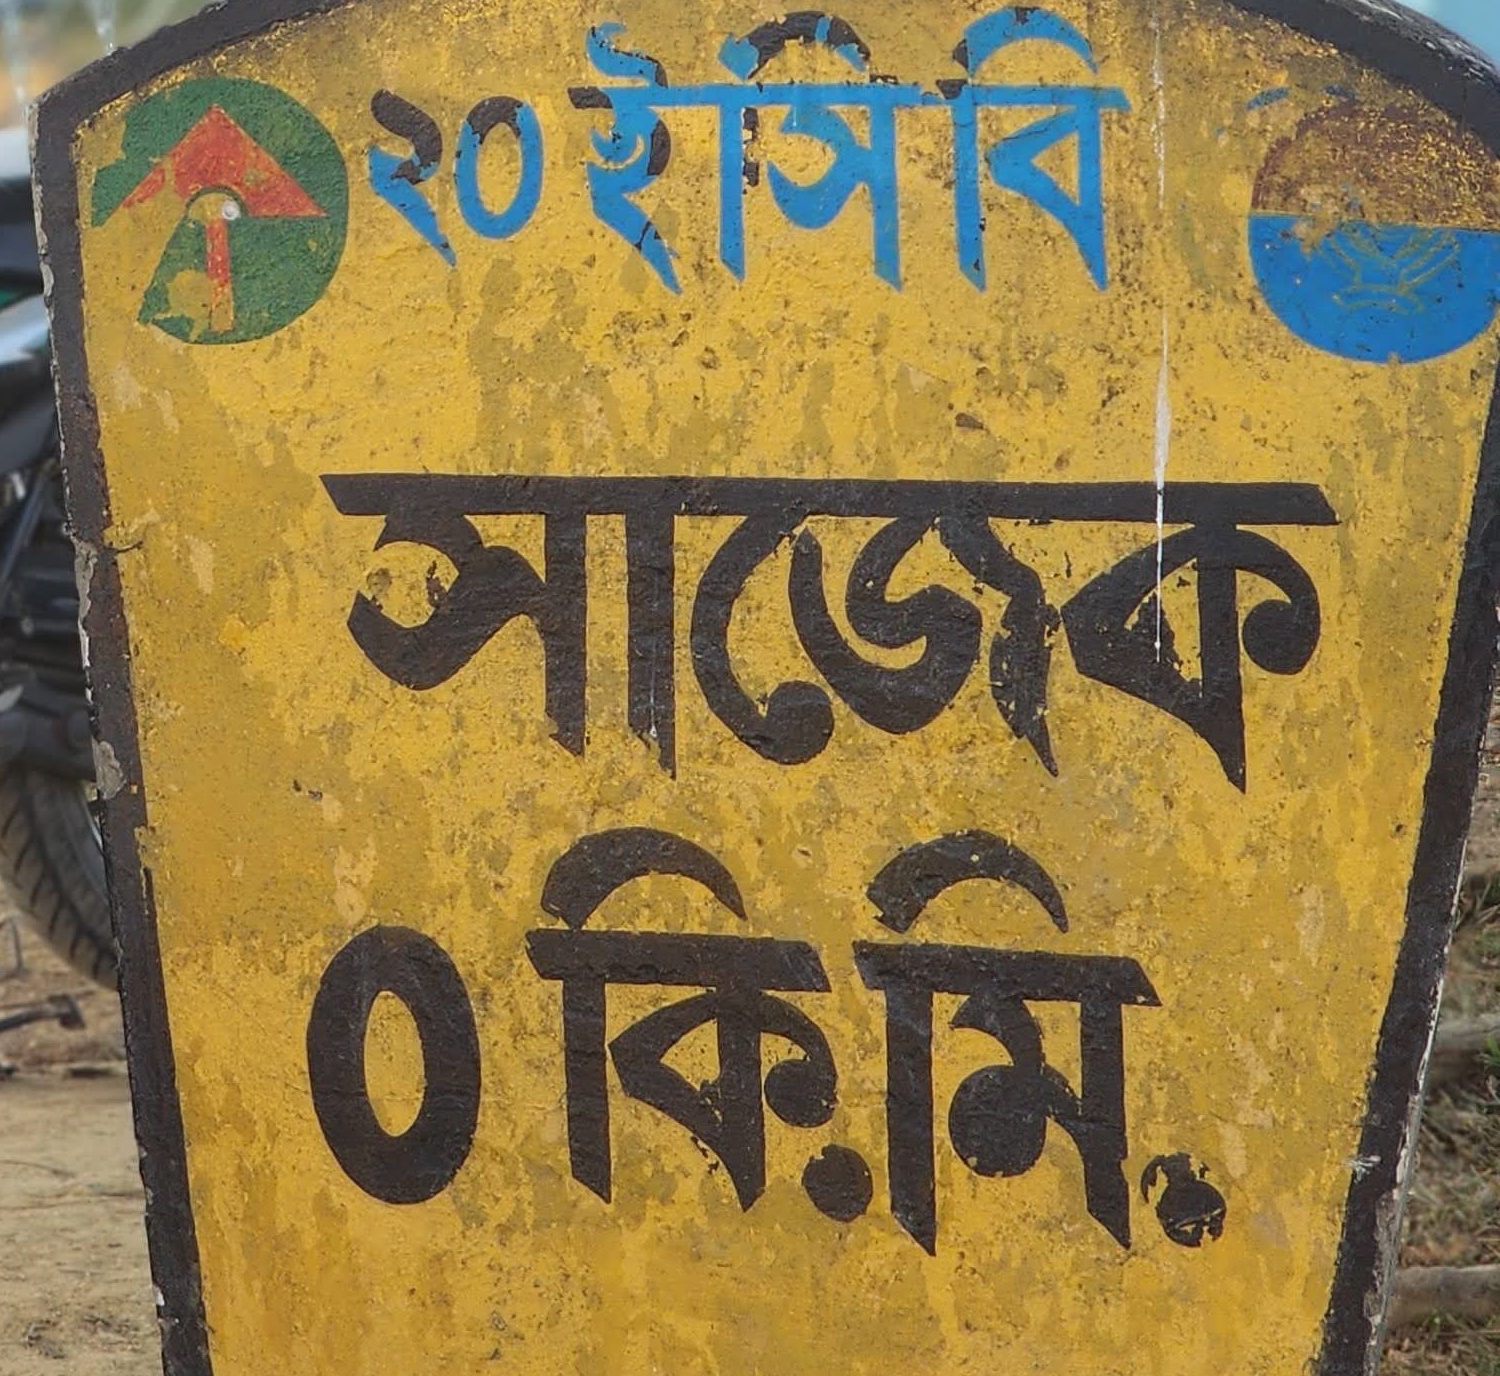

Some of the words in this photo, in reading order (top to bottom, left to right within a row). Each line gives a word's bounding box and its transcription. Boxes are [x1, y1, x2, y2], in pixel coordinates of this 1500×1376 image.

[368, 87, 546, 268] ২০
[568, 7, 1133, 295] ইসিবি
[322, 474, 1338, 794] সাজেক
[306, 925, 482, 1206] ০
